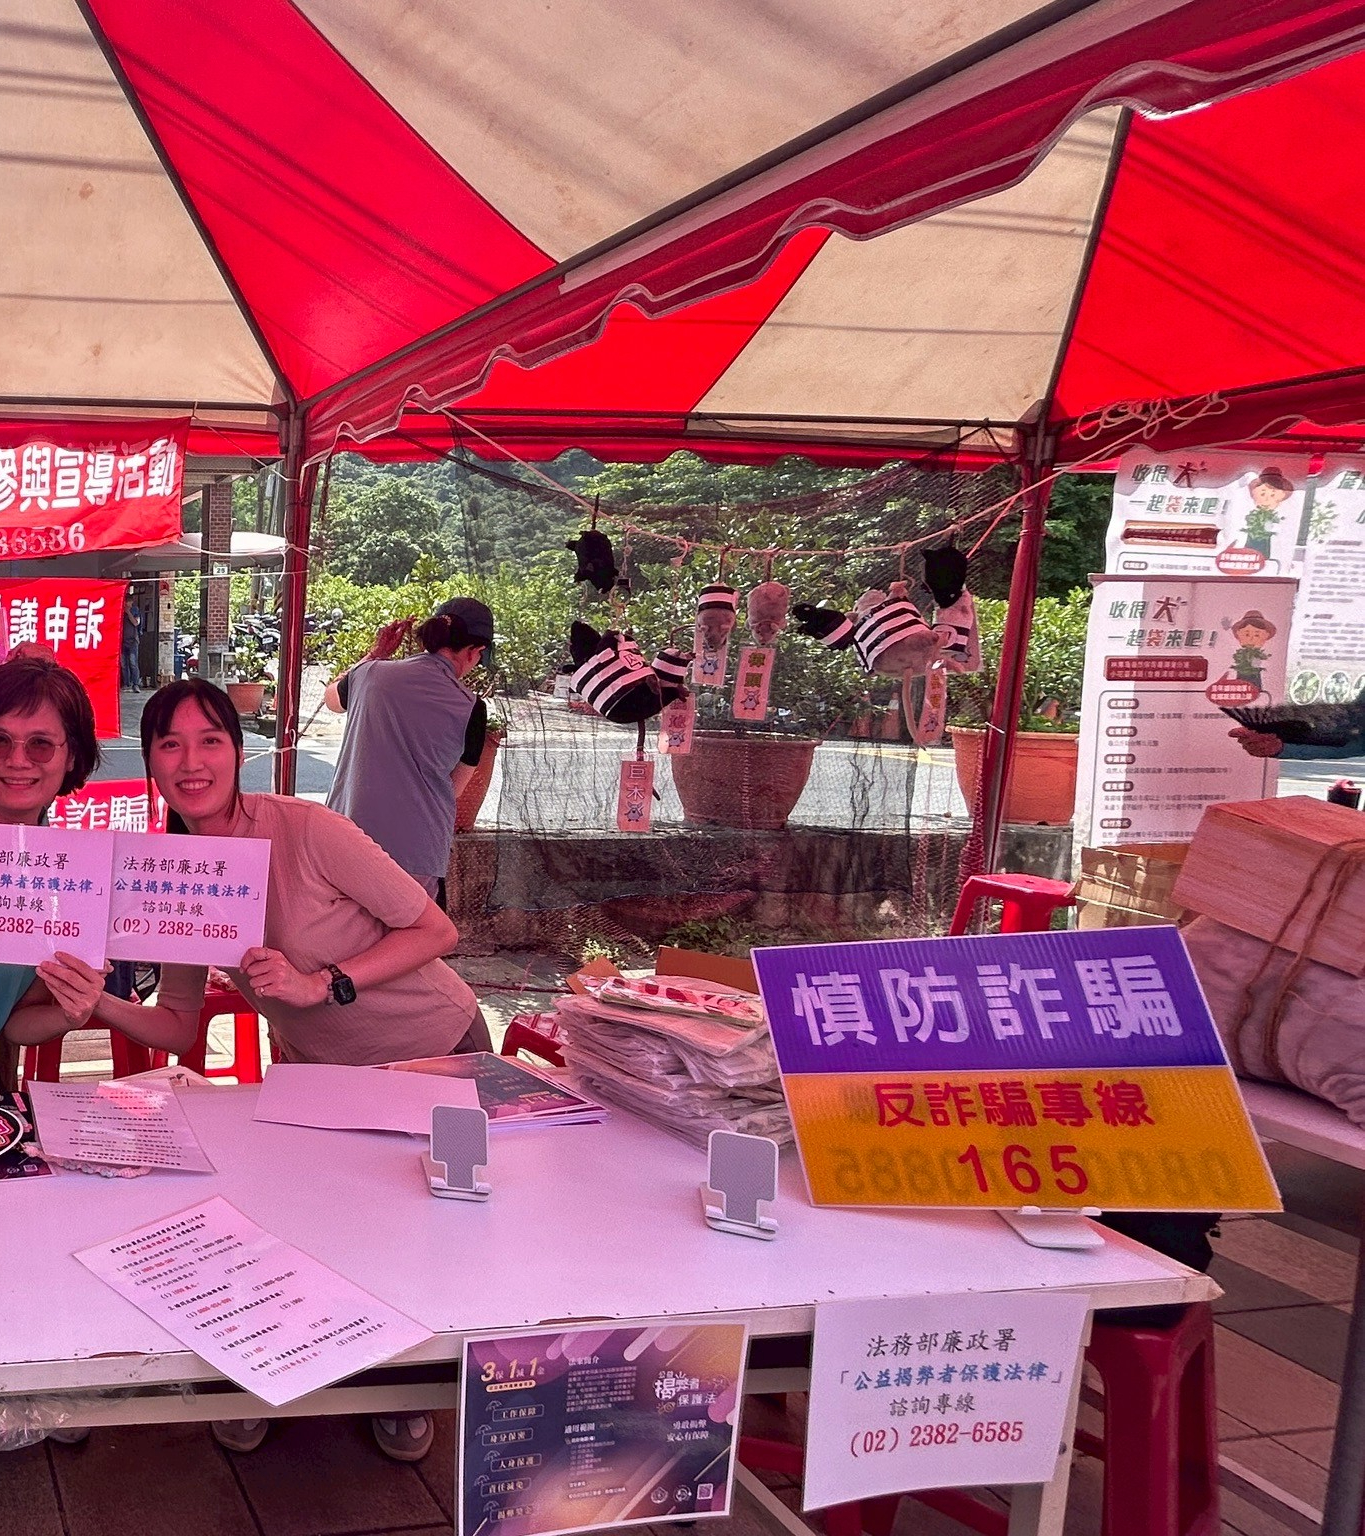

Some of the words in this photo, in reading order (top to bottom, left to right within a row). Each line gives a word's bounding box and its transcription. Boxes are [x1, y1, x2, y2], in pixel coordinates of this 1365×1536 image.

[1108, 629, 1218, 647] 一起袋來吧!
[626, 764, 647, 800] 巨木
[123, 856, 228, 877] 法務部廉政署
[142, 901, 205, 917] 諮詢專線
[158, 920, 238, 939] 2382-6585
[790, 954, 1183, 1046] 慎防詐騙
[874, 1079, 1155, 1128] 反詐騙專線
[958, 1144, 1089, 1196] 165
[866, 1328, 1017, 1358] 法務部廉政署
[889, 1392, 976, 1417] 諮詢專線
[909, 1421, 1024, 1447] 2382-6585
